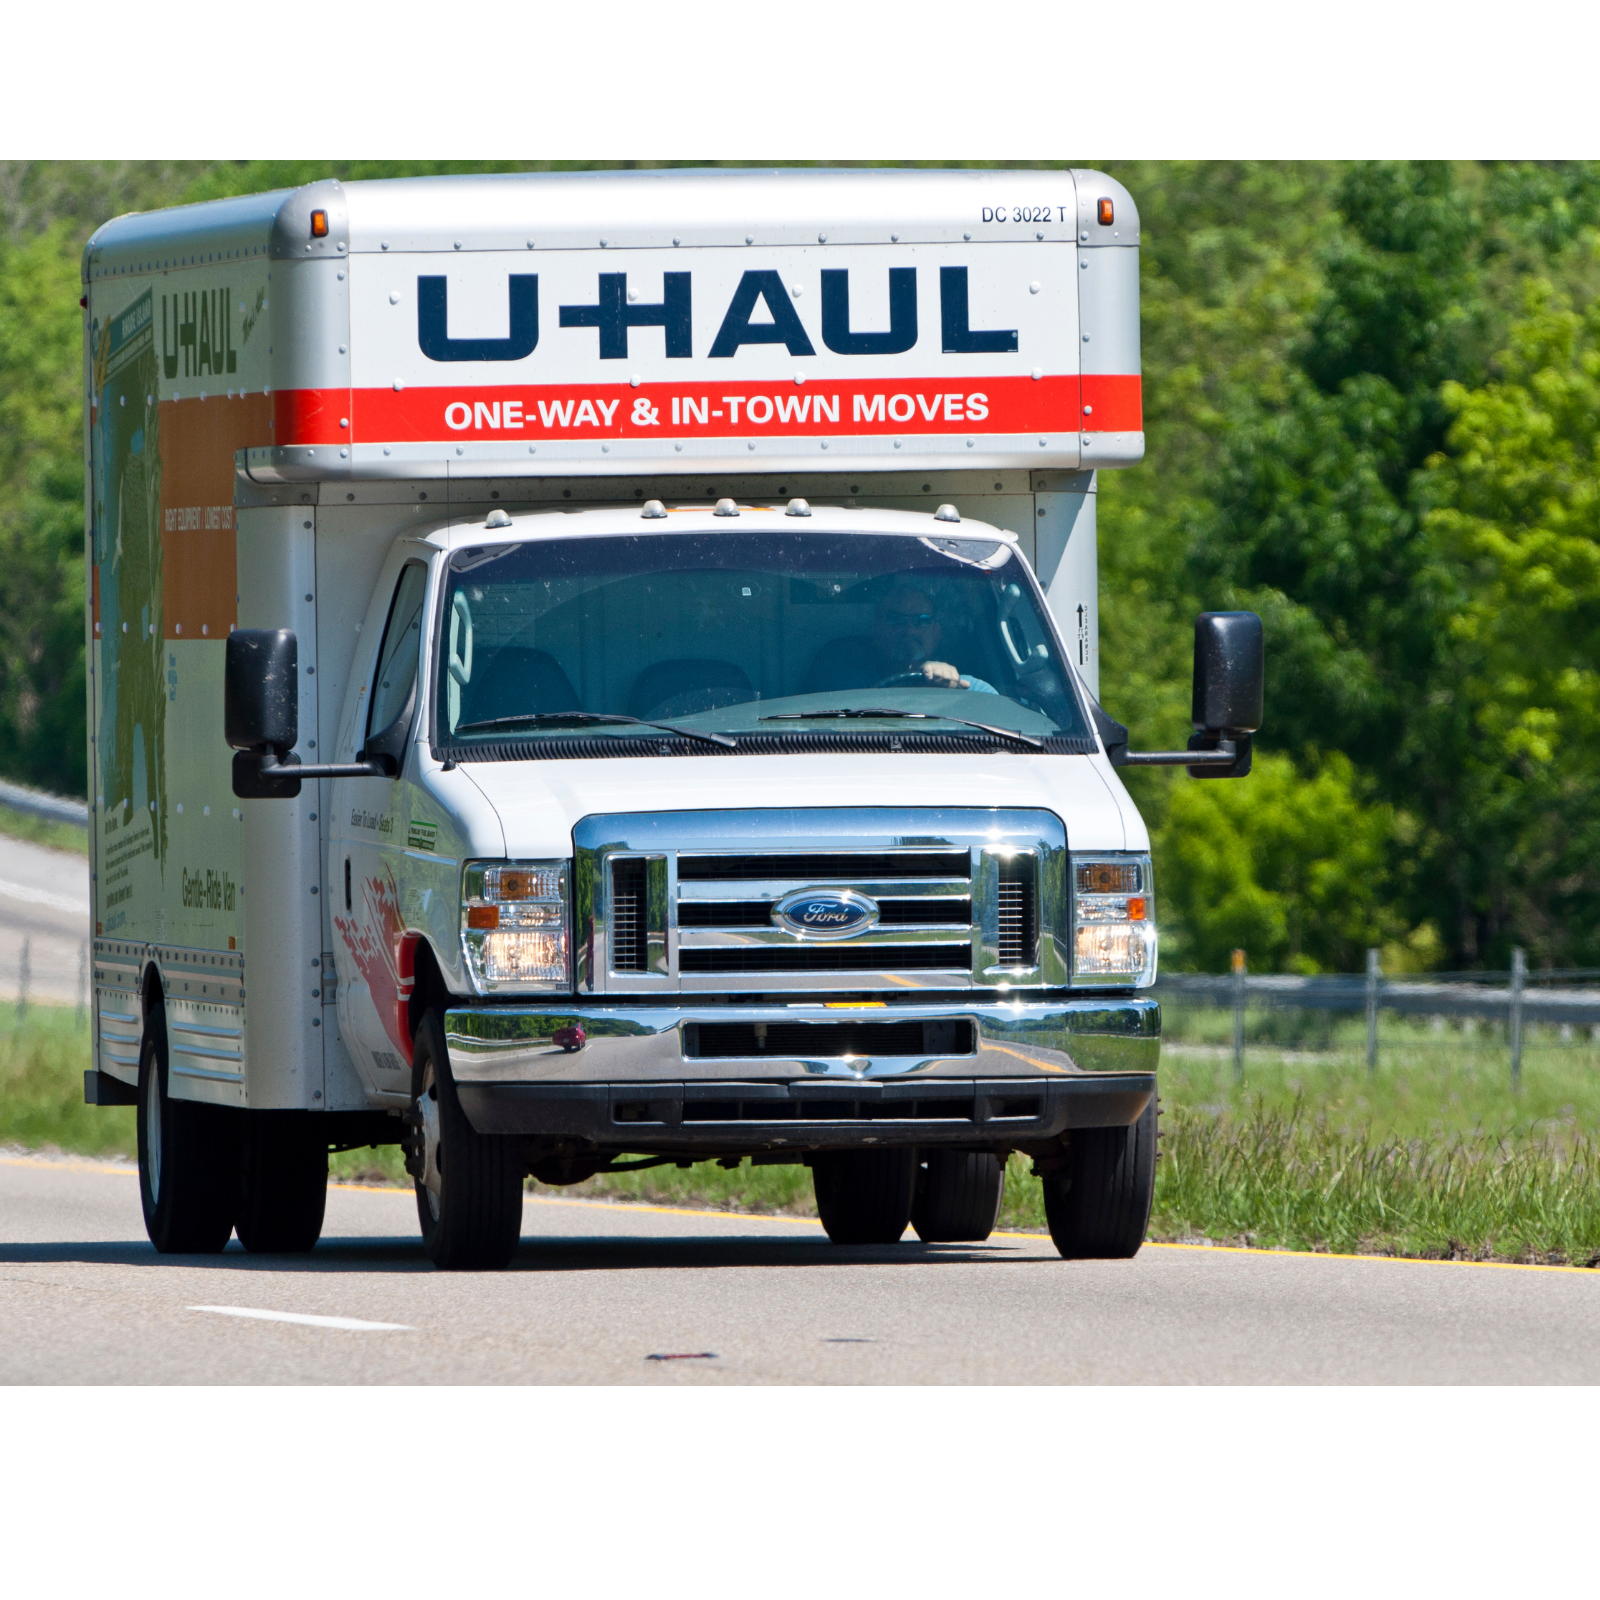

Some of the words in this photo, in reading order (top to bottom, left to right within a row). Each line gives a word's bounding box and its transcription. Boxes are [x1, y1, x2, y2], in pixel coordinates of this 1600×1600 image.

[982, 206, 1007, 223] DC
[1012, 206, 1052, 223] 3022
[1056, 206, 1067, 222] T
[162, 287, 237, 379] U-HAUL
[418, 266, 1018, 362] U-HAUL
[444, 398, 621, 431] ONE-WAY
[630, 397, 661, 427] &
[671, 394, 840, 425] IN-TOWN
[852, 392, 990, 423] MOVES
[182, 866, 222, 910] Gentle-Ride
[222, 871, 236, 912] Van
[803, 902, 850, 923] Ford
